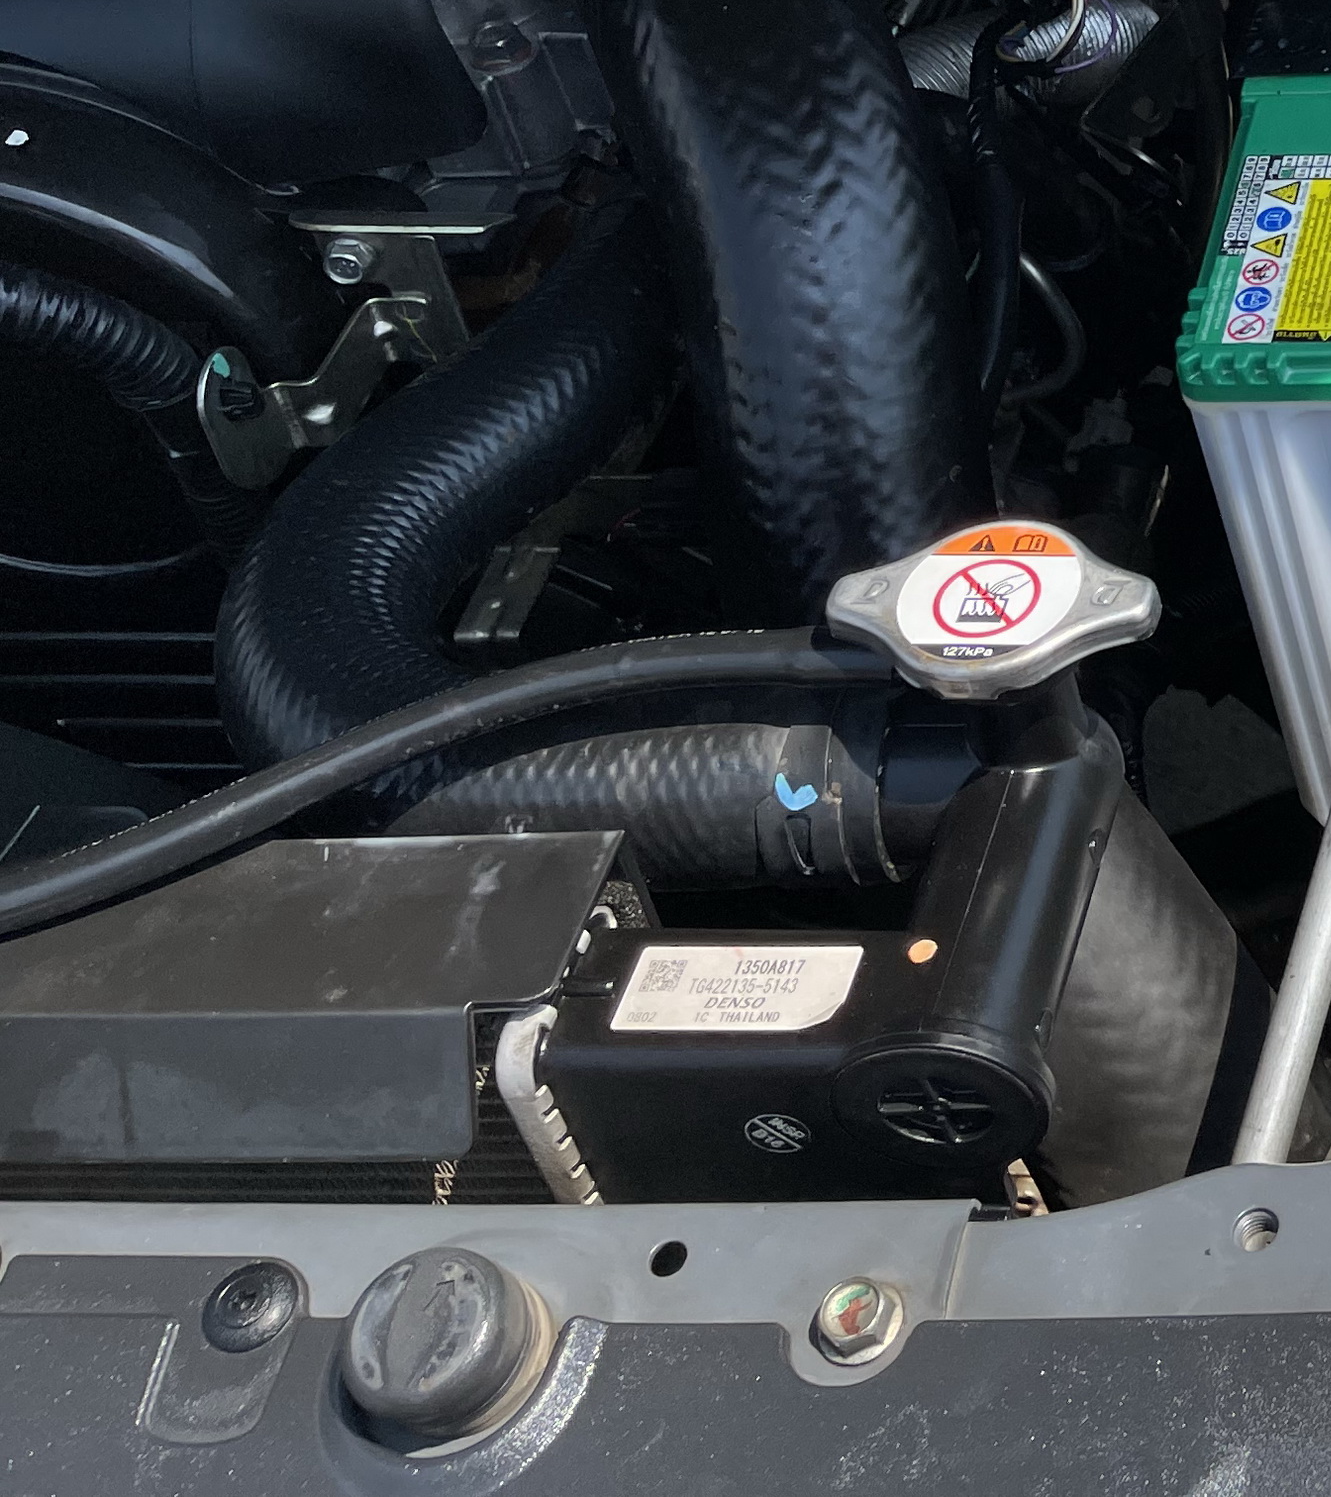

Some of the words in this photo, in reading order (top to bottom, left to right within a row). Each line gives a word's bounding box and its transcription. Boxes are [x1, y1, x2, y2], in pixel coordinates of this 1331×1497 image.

[942, 646, 994, 657] 127kPa
[733, 960, 806, 975] 1350A817
[688, 978, 799, 994] TG422135-5143
[703, 997, 766, 1009] DENSO
[626, 1012, 657, 1022] 0802
[719, 1012, 780, 1022] THAILAND
